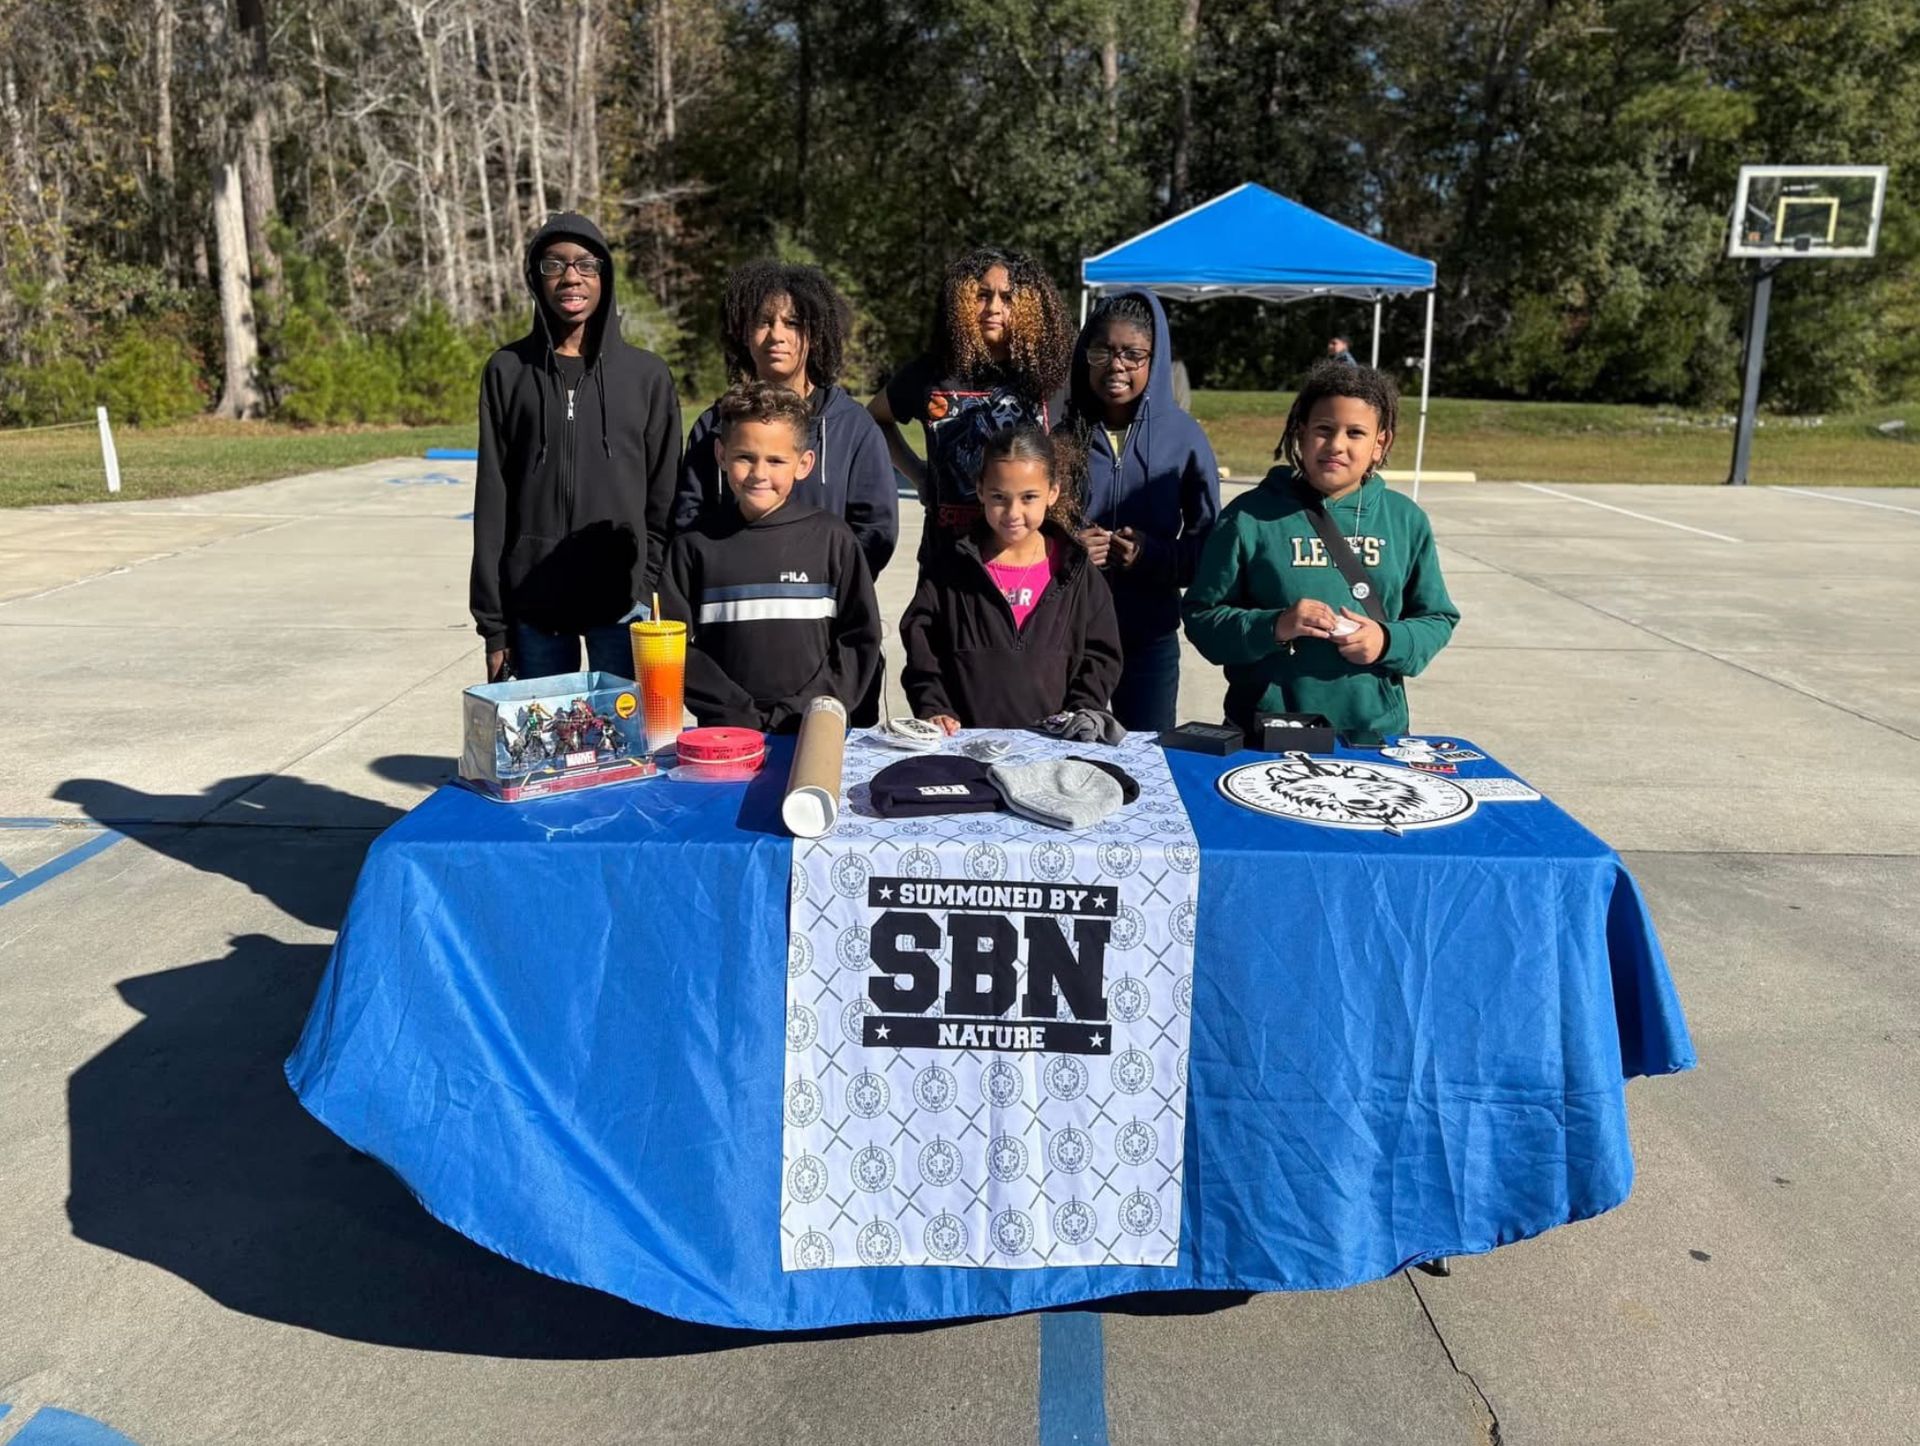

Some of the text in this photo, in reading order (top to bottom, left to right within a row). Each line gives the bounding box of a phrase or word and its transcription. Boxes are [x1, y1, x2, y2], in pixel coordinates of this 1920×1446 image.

[780, 571, 809, 582] FILA
[566, 751, 596, 767] MARVEL
[899, 883, 1088, 911] SUMMONED BY
[868, 911, 1112, 1021] SBN
[938, 1023, 1046, 1049] NATURE
